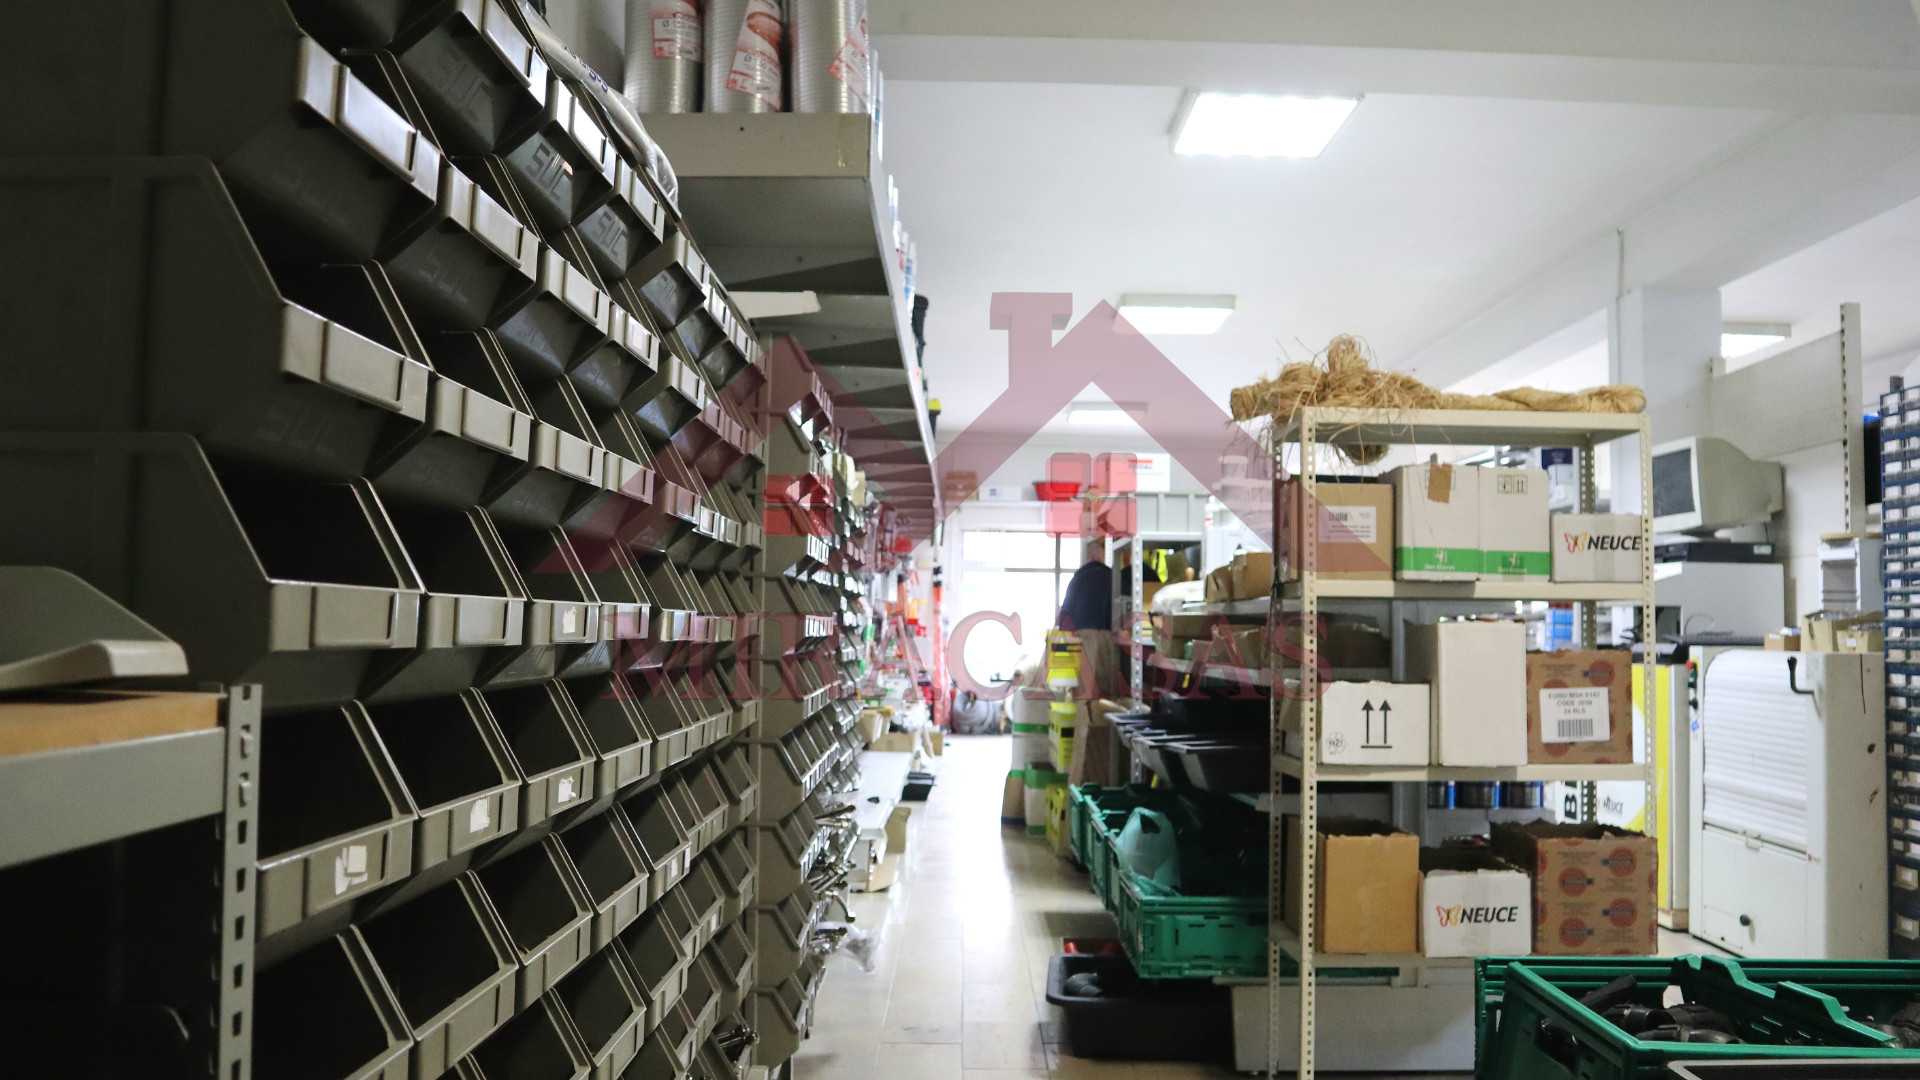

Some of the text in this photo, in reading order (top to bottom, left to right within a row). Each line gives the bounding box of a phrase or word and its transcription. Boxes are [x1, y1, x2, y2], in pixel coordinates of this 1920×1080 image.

[525, 142, 574, 201] SUC
[592, 210, 630, 258] SUC
[1587, 535, 1642, 551] NEUCE
[1460, 906, 1519, 924] NEUCE
